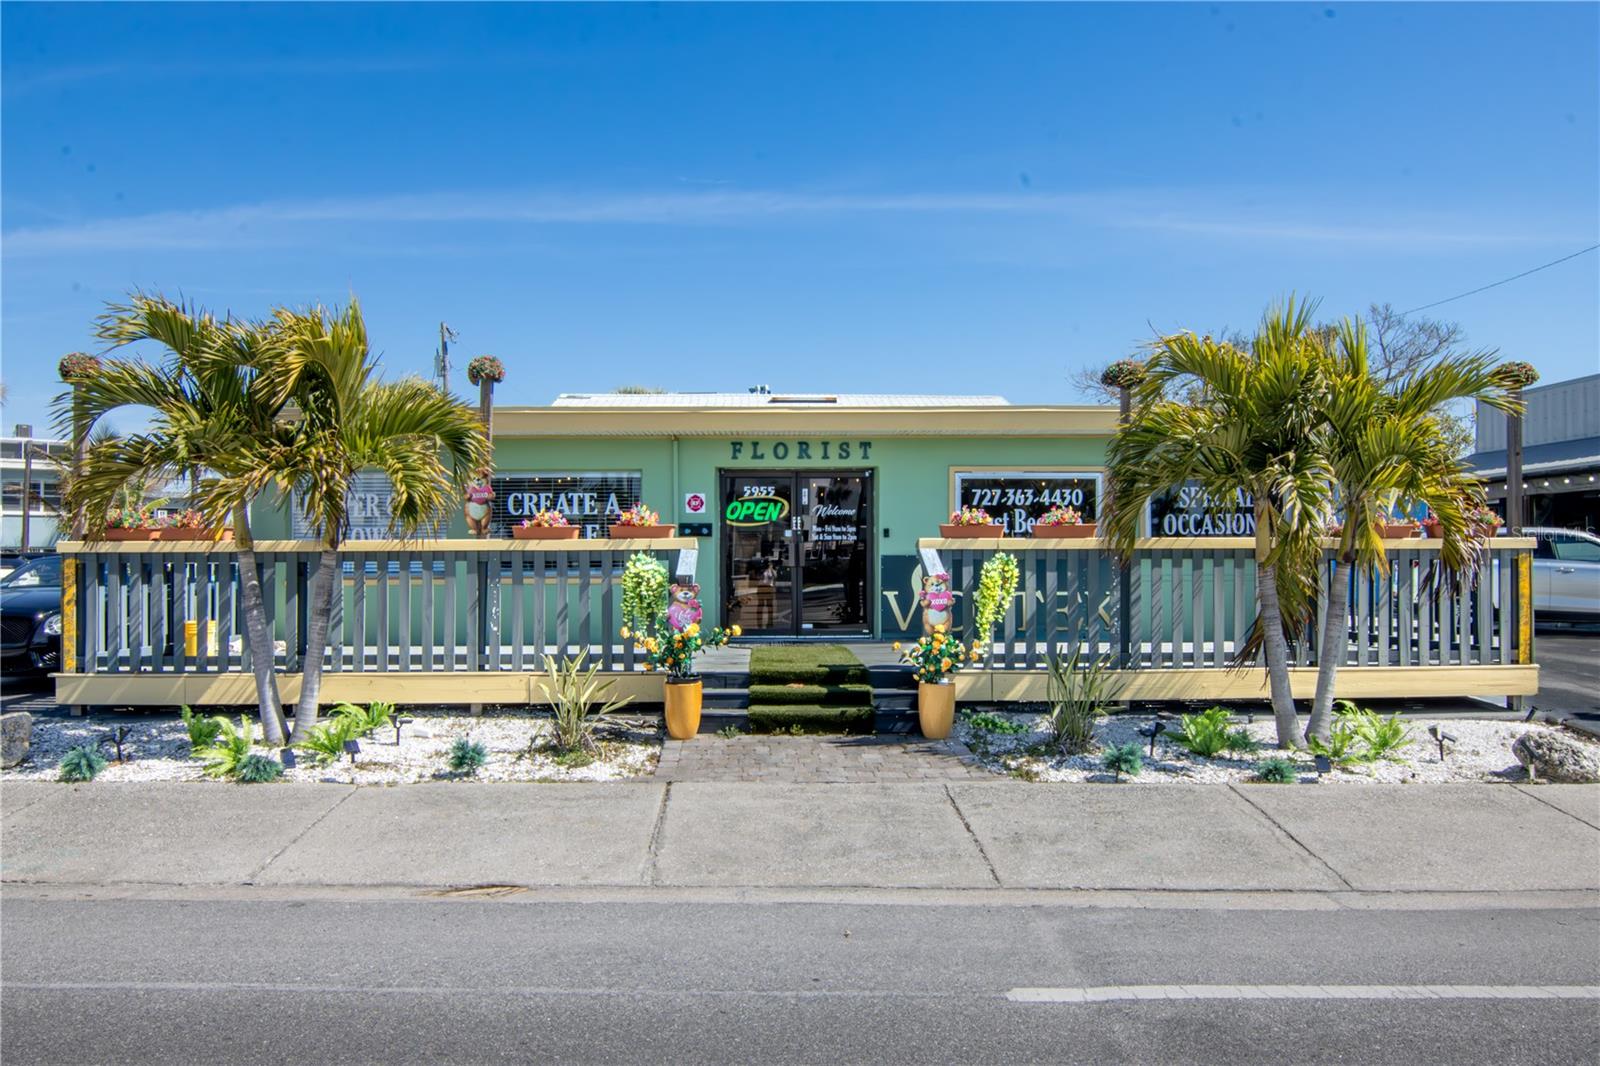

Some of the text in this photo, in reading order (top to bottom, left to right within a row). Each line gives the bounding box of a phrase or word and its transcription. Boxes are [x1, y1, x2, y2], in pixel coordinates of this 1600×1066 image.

[730, 441, 872, 460] FLORIST
[743, 486, 776, 497] 5955
[971, 488, 1084, 506] 727-363-4430
[507, 492, 621, 516] CREATE A
[726, 501, 782, 522] OPEN
[812, 503, 857, 518] Welcome
[1163, 513, 1257, 536] OCCASION
